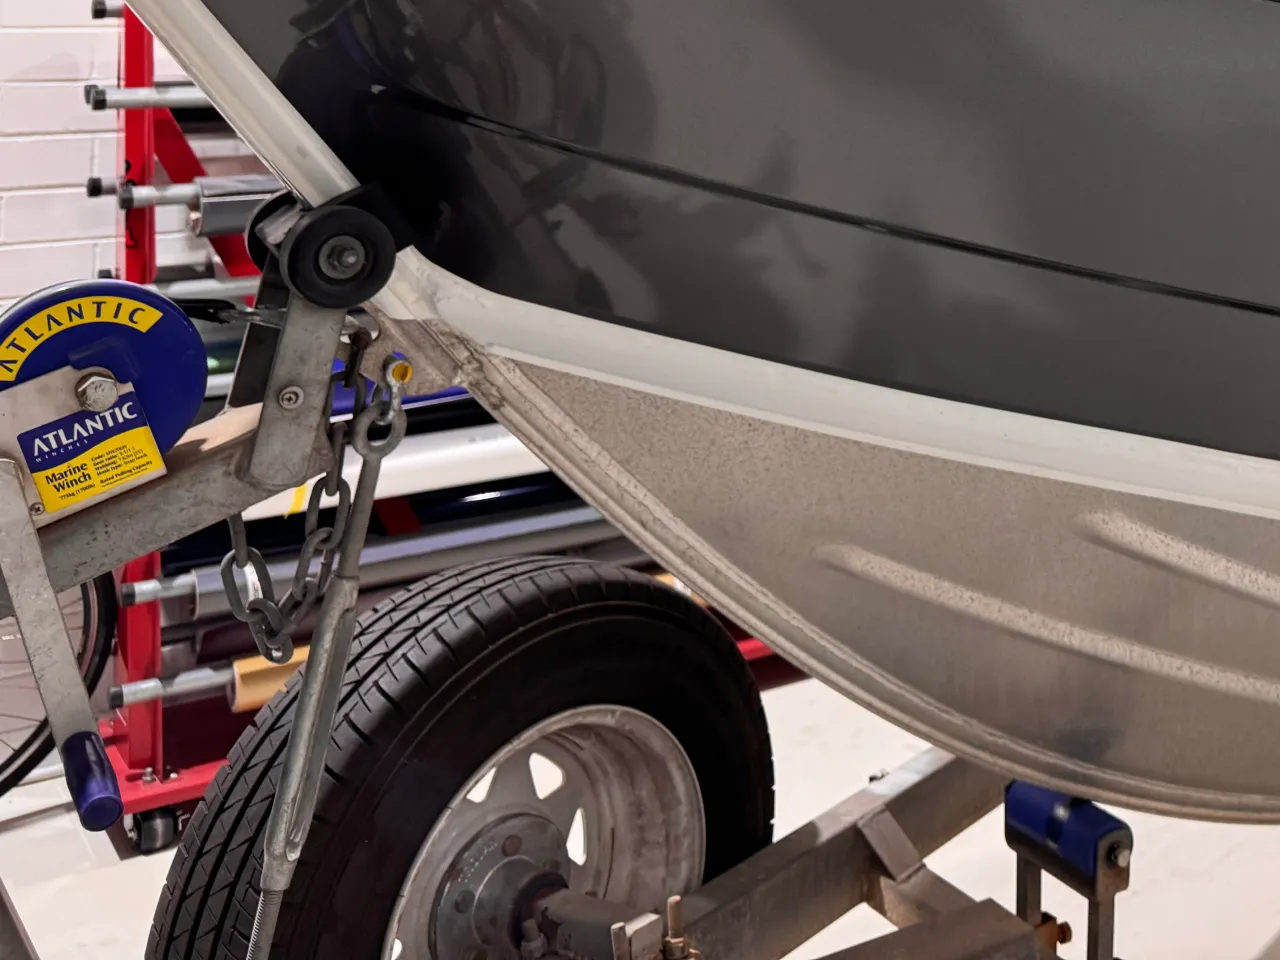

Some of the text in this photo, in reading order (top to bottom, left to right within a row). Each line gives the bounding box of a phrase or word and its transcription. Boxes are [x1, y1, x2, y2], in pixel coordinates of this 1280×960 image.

[0, 301, 146, 373] ATLANTIC
[34, 401, 137, 456] ATLANTIC
[35, 439, 88, 463] WINCHES
[45, 462, 88, 484] Marine
[53, 471, 92, 492] Winch
